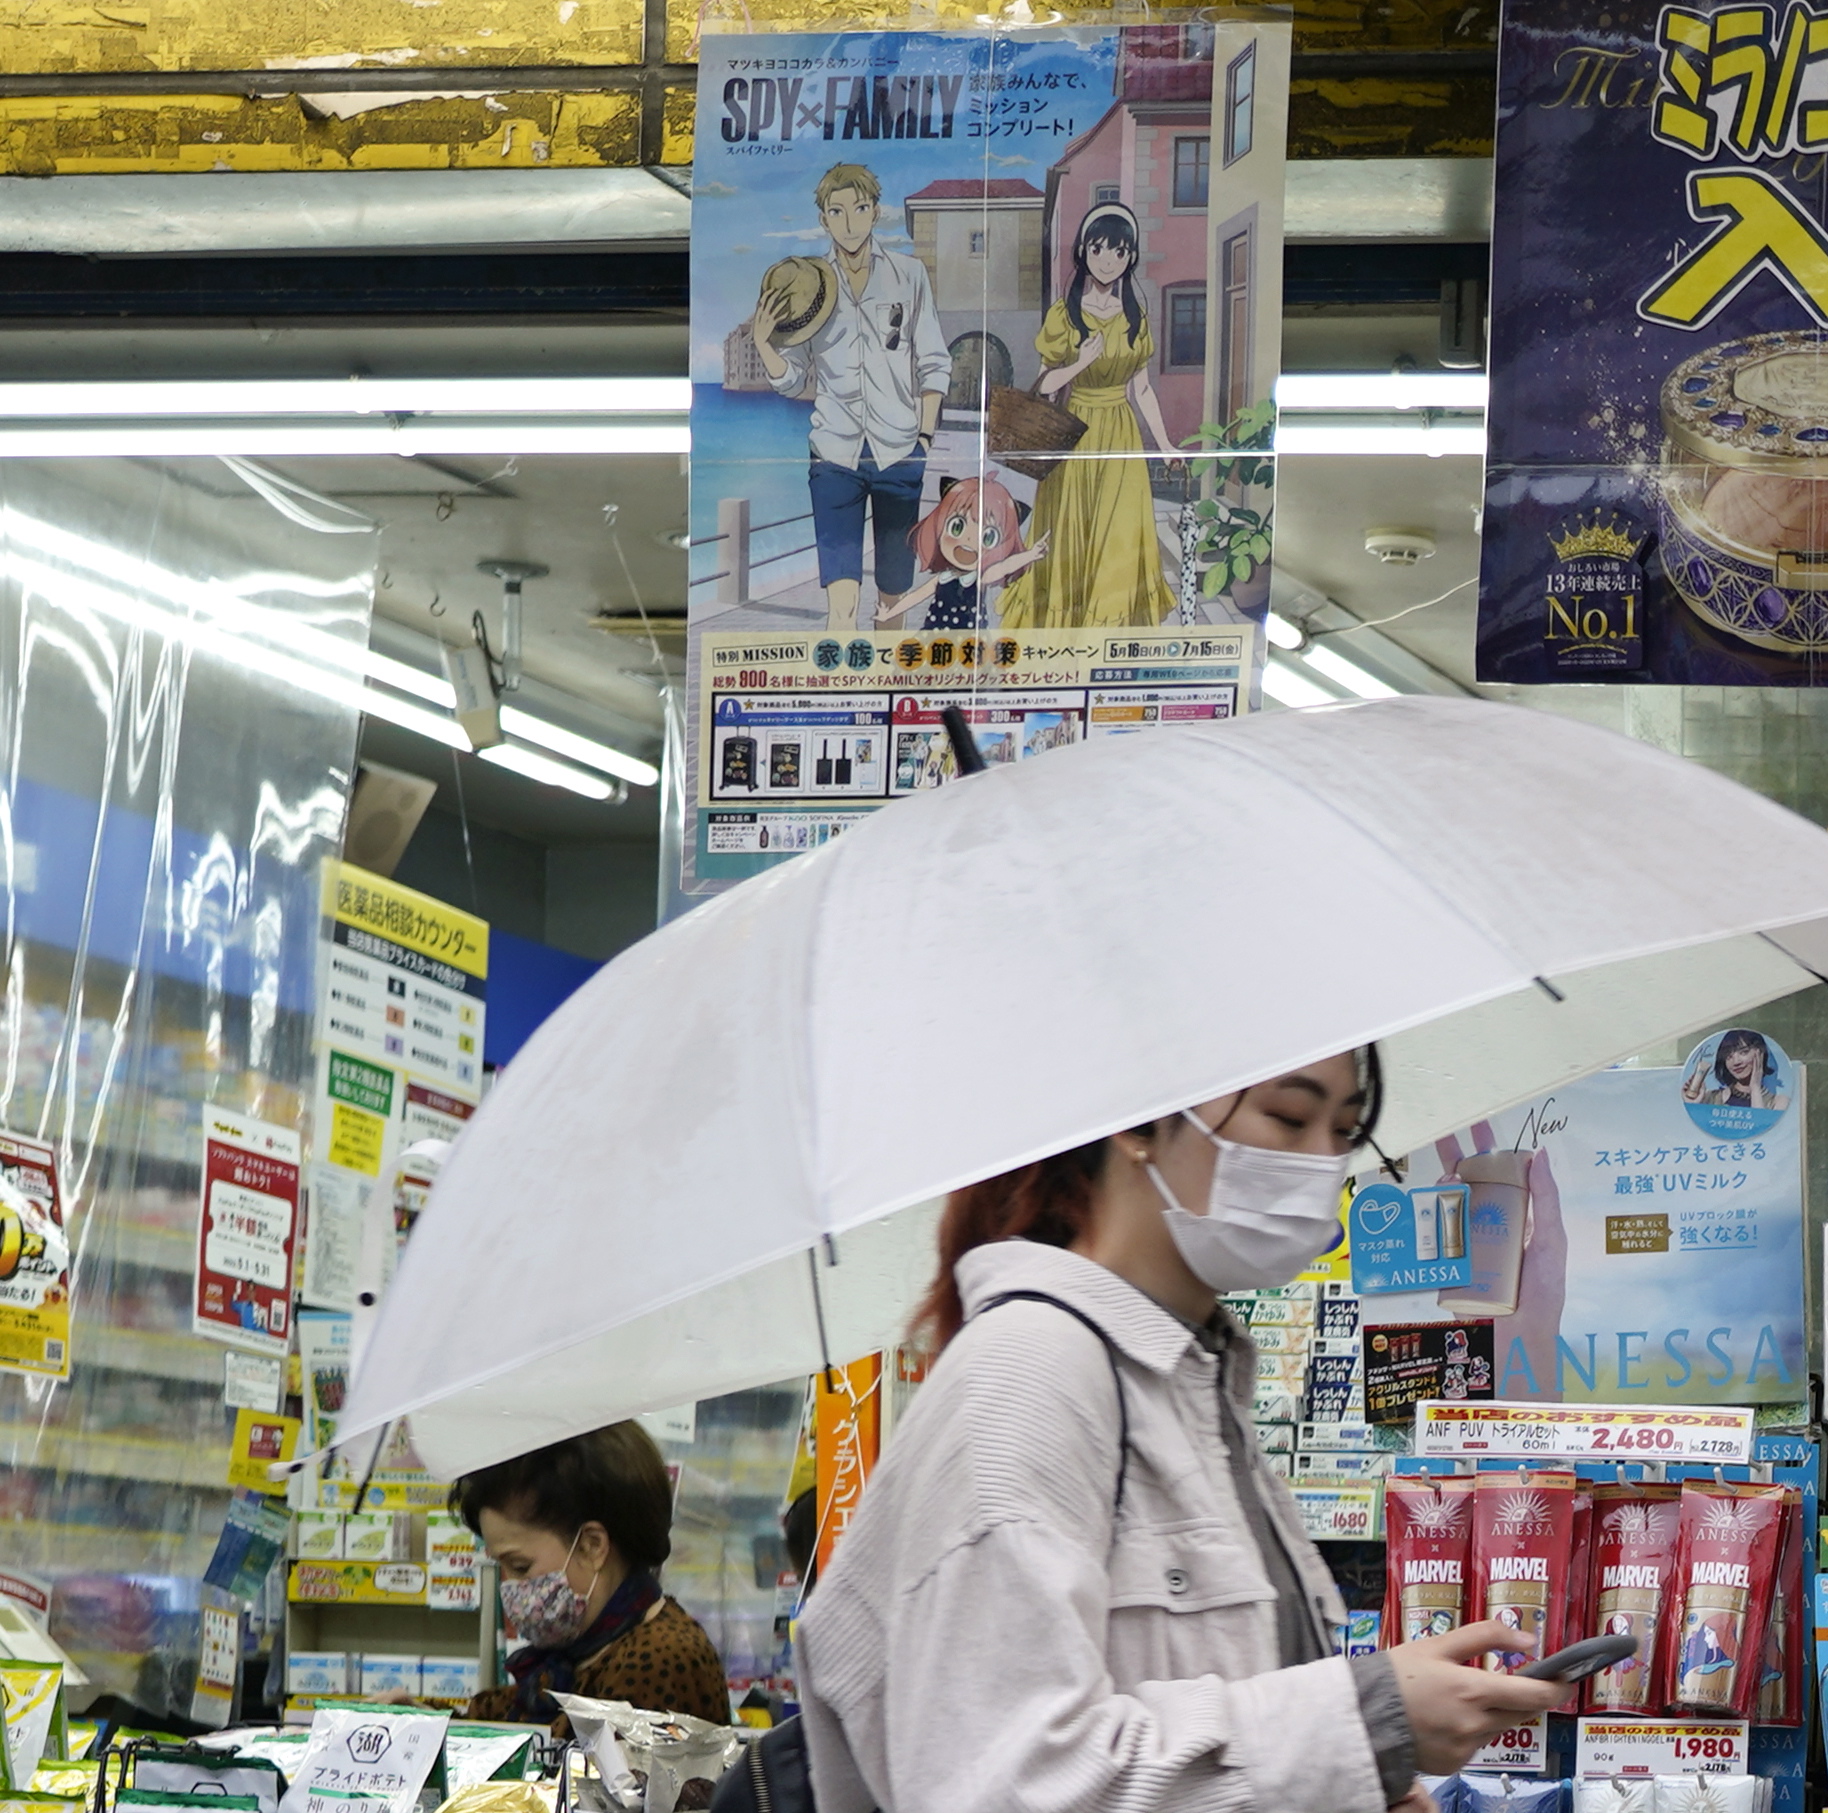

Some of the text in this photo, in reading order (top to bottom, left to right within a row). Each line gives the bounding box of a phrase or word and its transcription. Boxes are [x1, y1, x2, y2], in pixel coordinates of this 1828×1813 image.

[968, 98, 1048, 114] ミッション
[1545, 574, 1641, 593] 13年連続売上
[1544, 595, 1640, 640] No.1
[742, 645, 806, 662] MISSION
[1513, 1097, 1569, 1153] New
[1594, 1142, 1766, 1168] スキンケアもできる
[1357, 1238, 1405, 1253] マスク蒸れ
[1370, 1253, 1391, 1264] 対応
[1390, 1265, 1461, 1285] ANESSA
[1501, 1325, 1795, 1397] ANESSA
[1426, 1422, 1451, 1439] ANF
[1459, 1421, 1485, 1438] PUV
[1405, 1560, 1463, 1584] MARVEL
[1490, 1558, 1549, 1582] MARVEL
[314, 1767, 408, 1788] プライドポテト
